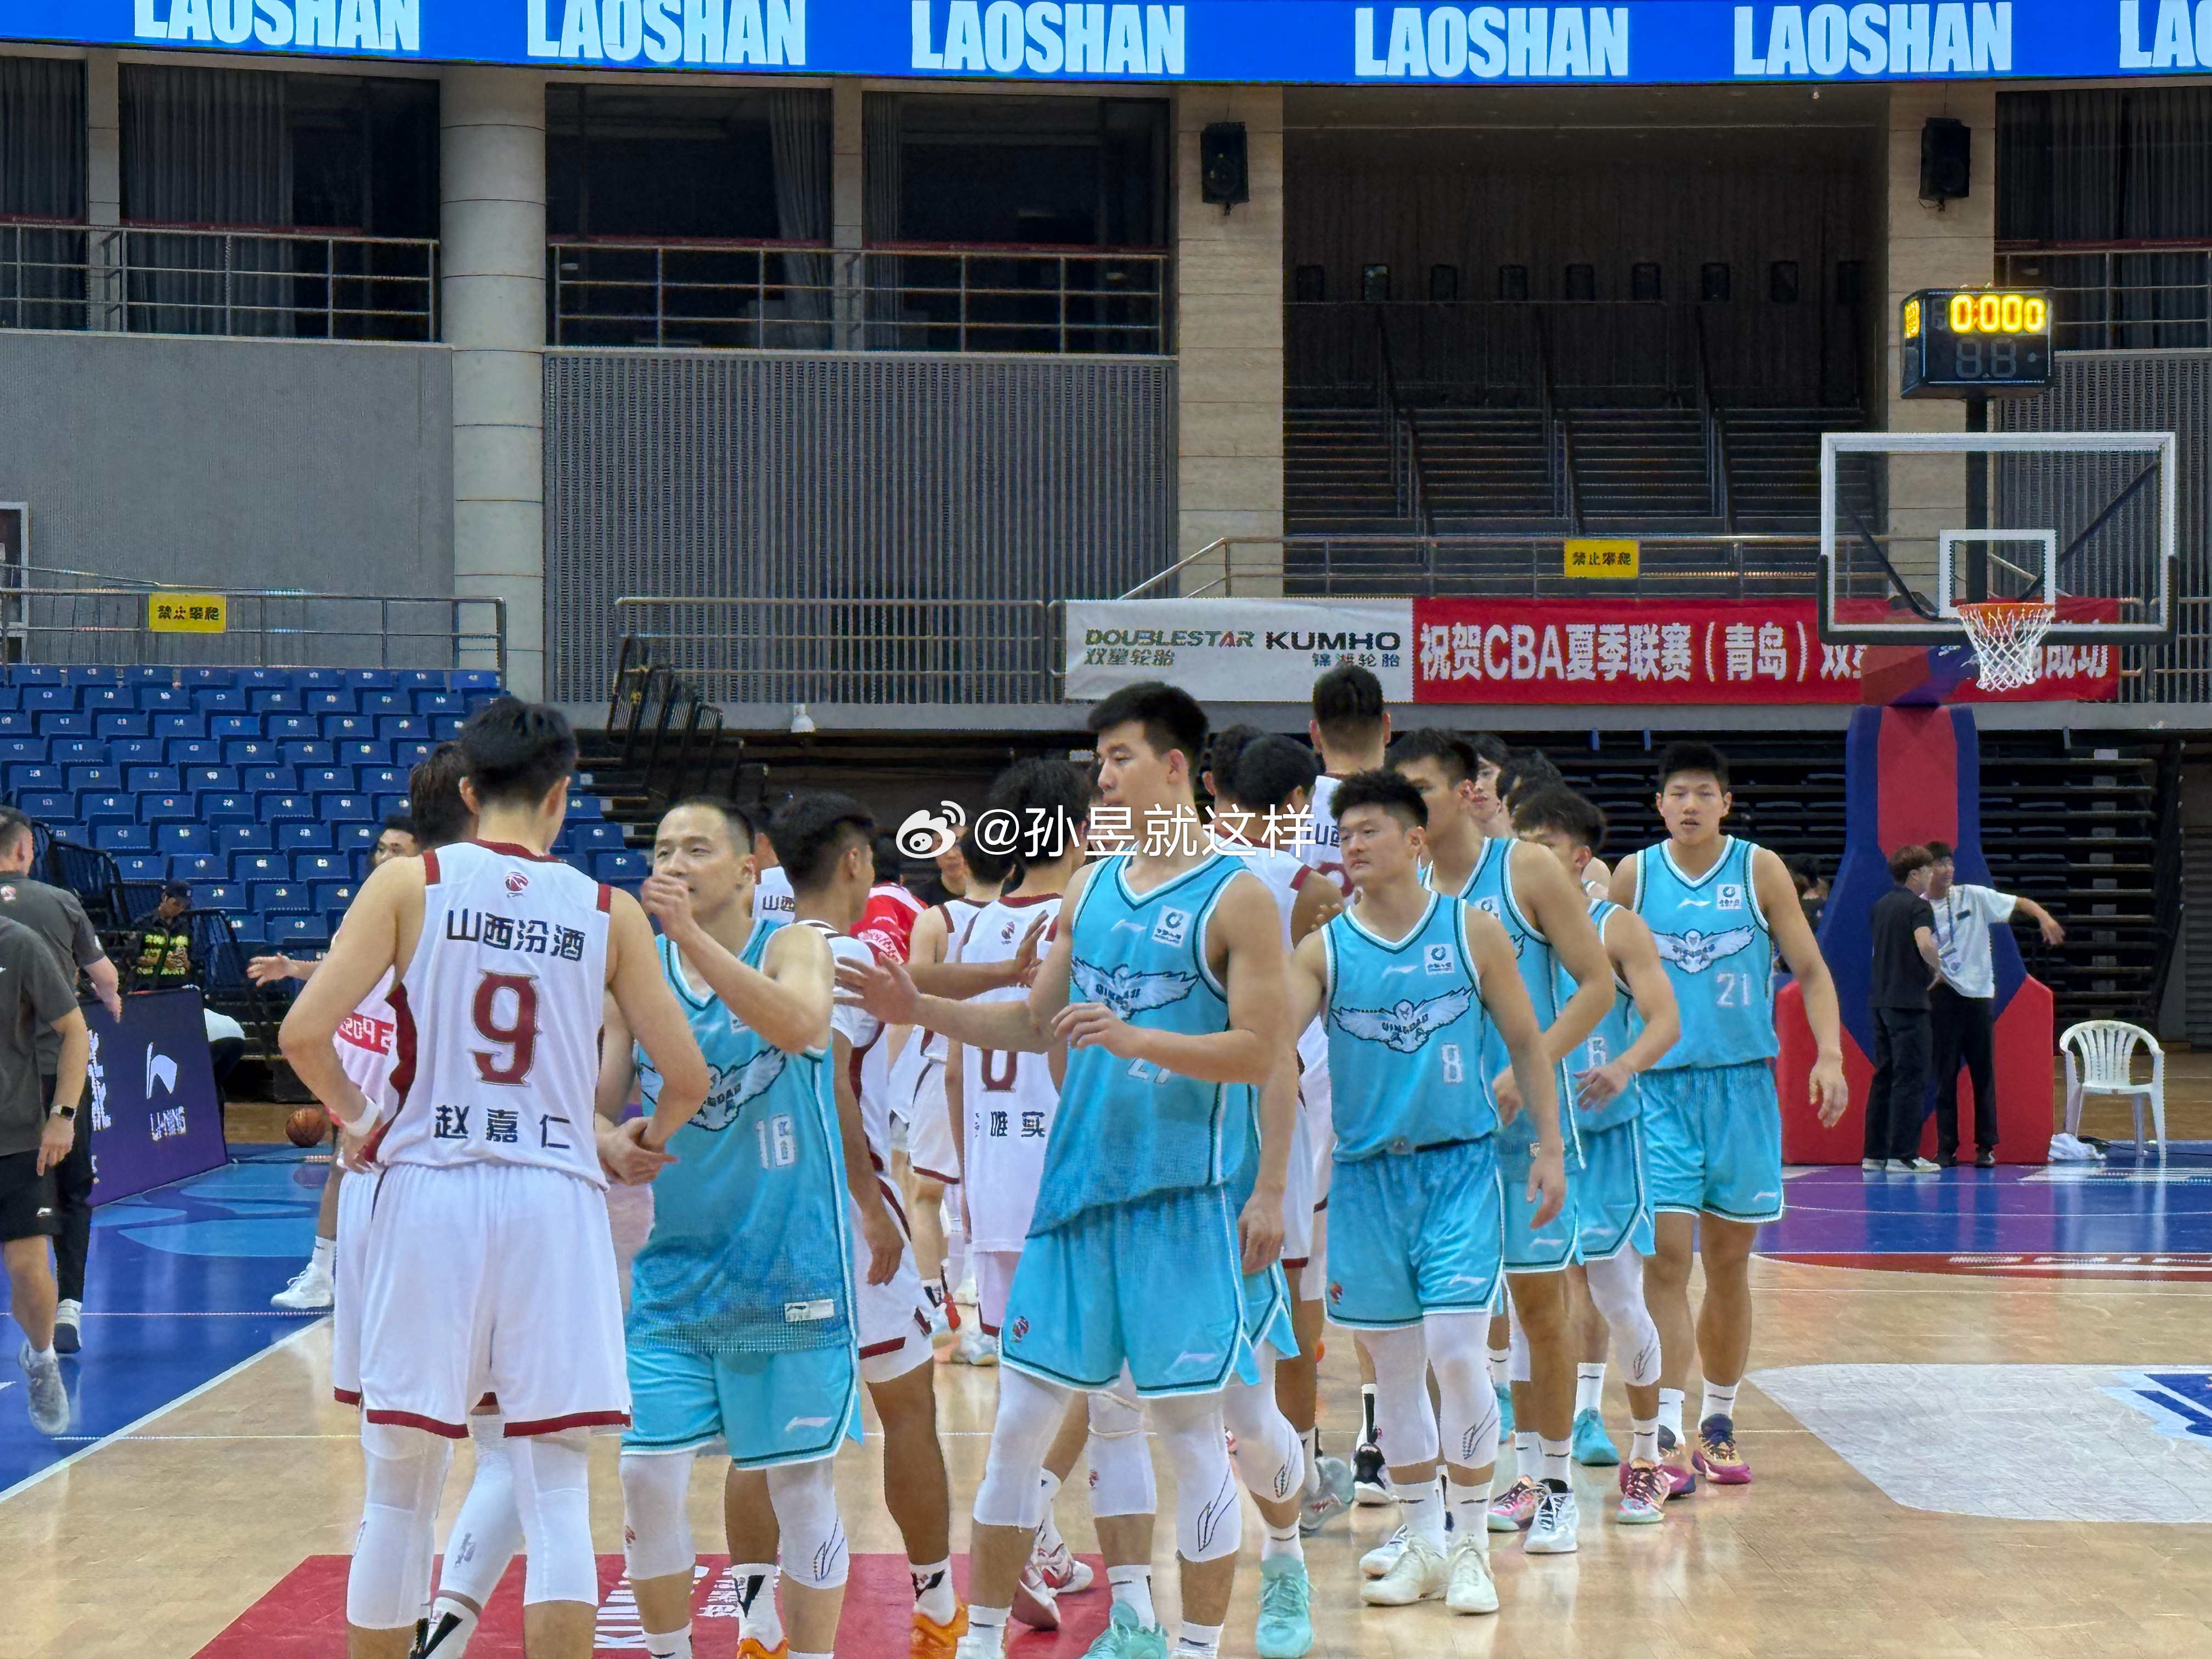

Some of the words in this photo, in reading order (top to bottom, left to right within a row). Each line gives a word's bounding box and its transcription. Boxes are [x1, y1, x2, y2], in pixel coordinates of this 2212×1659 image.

[133, 0, 420, 52] LAOSHAN
[527, 0, 806, 66] LAOSHAN
[911, 0, 1185, 75] LAOSHAN
[1355, 5, 1629, 78] LAOSHAN
[1733, 2, 2012, 76] LAOSHAN
[1085, 629, 1255, 648] DOUBLESTAR
[1265, 631, 1401, 651] KUMHO
[447, 908, 585, 962] 山西汾酒
[1716, 973, 1750, 1006] 21
[469, 969, 541, 1087] 9
[1441, 1043, 1463, 1084] 8
[433, 1104, 571, 1149] 赵嘉仁
[756, 1114, 795, 1169] 16
